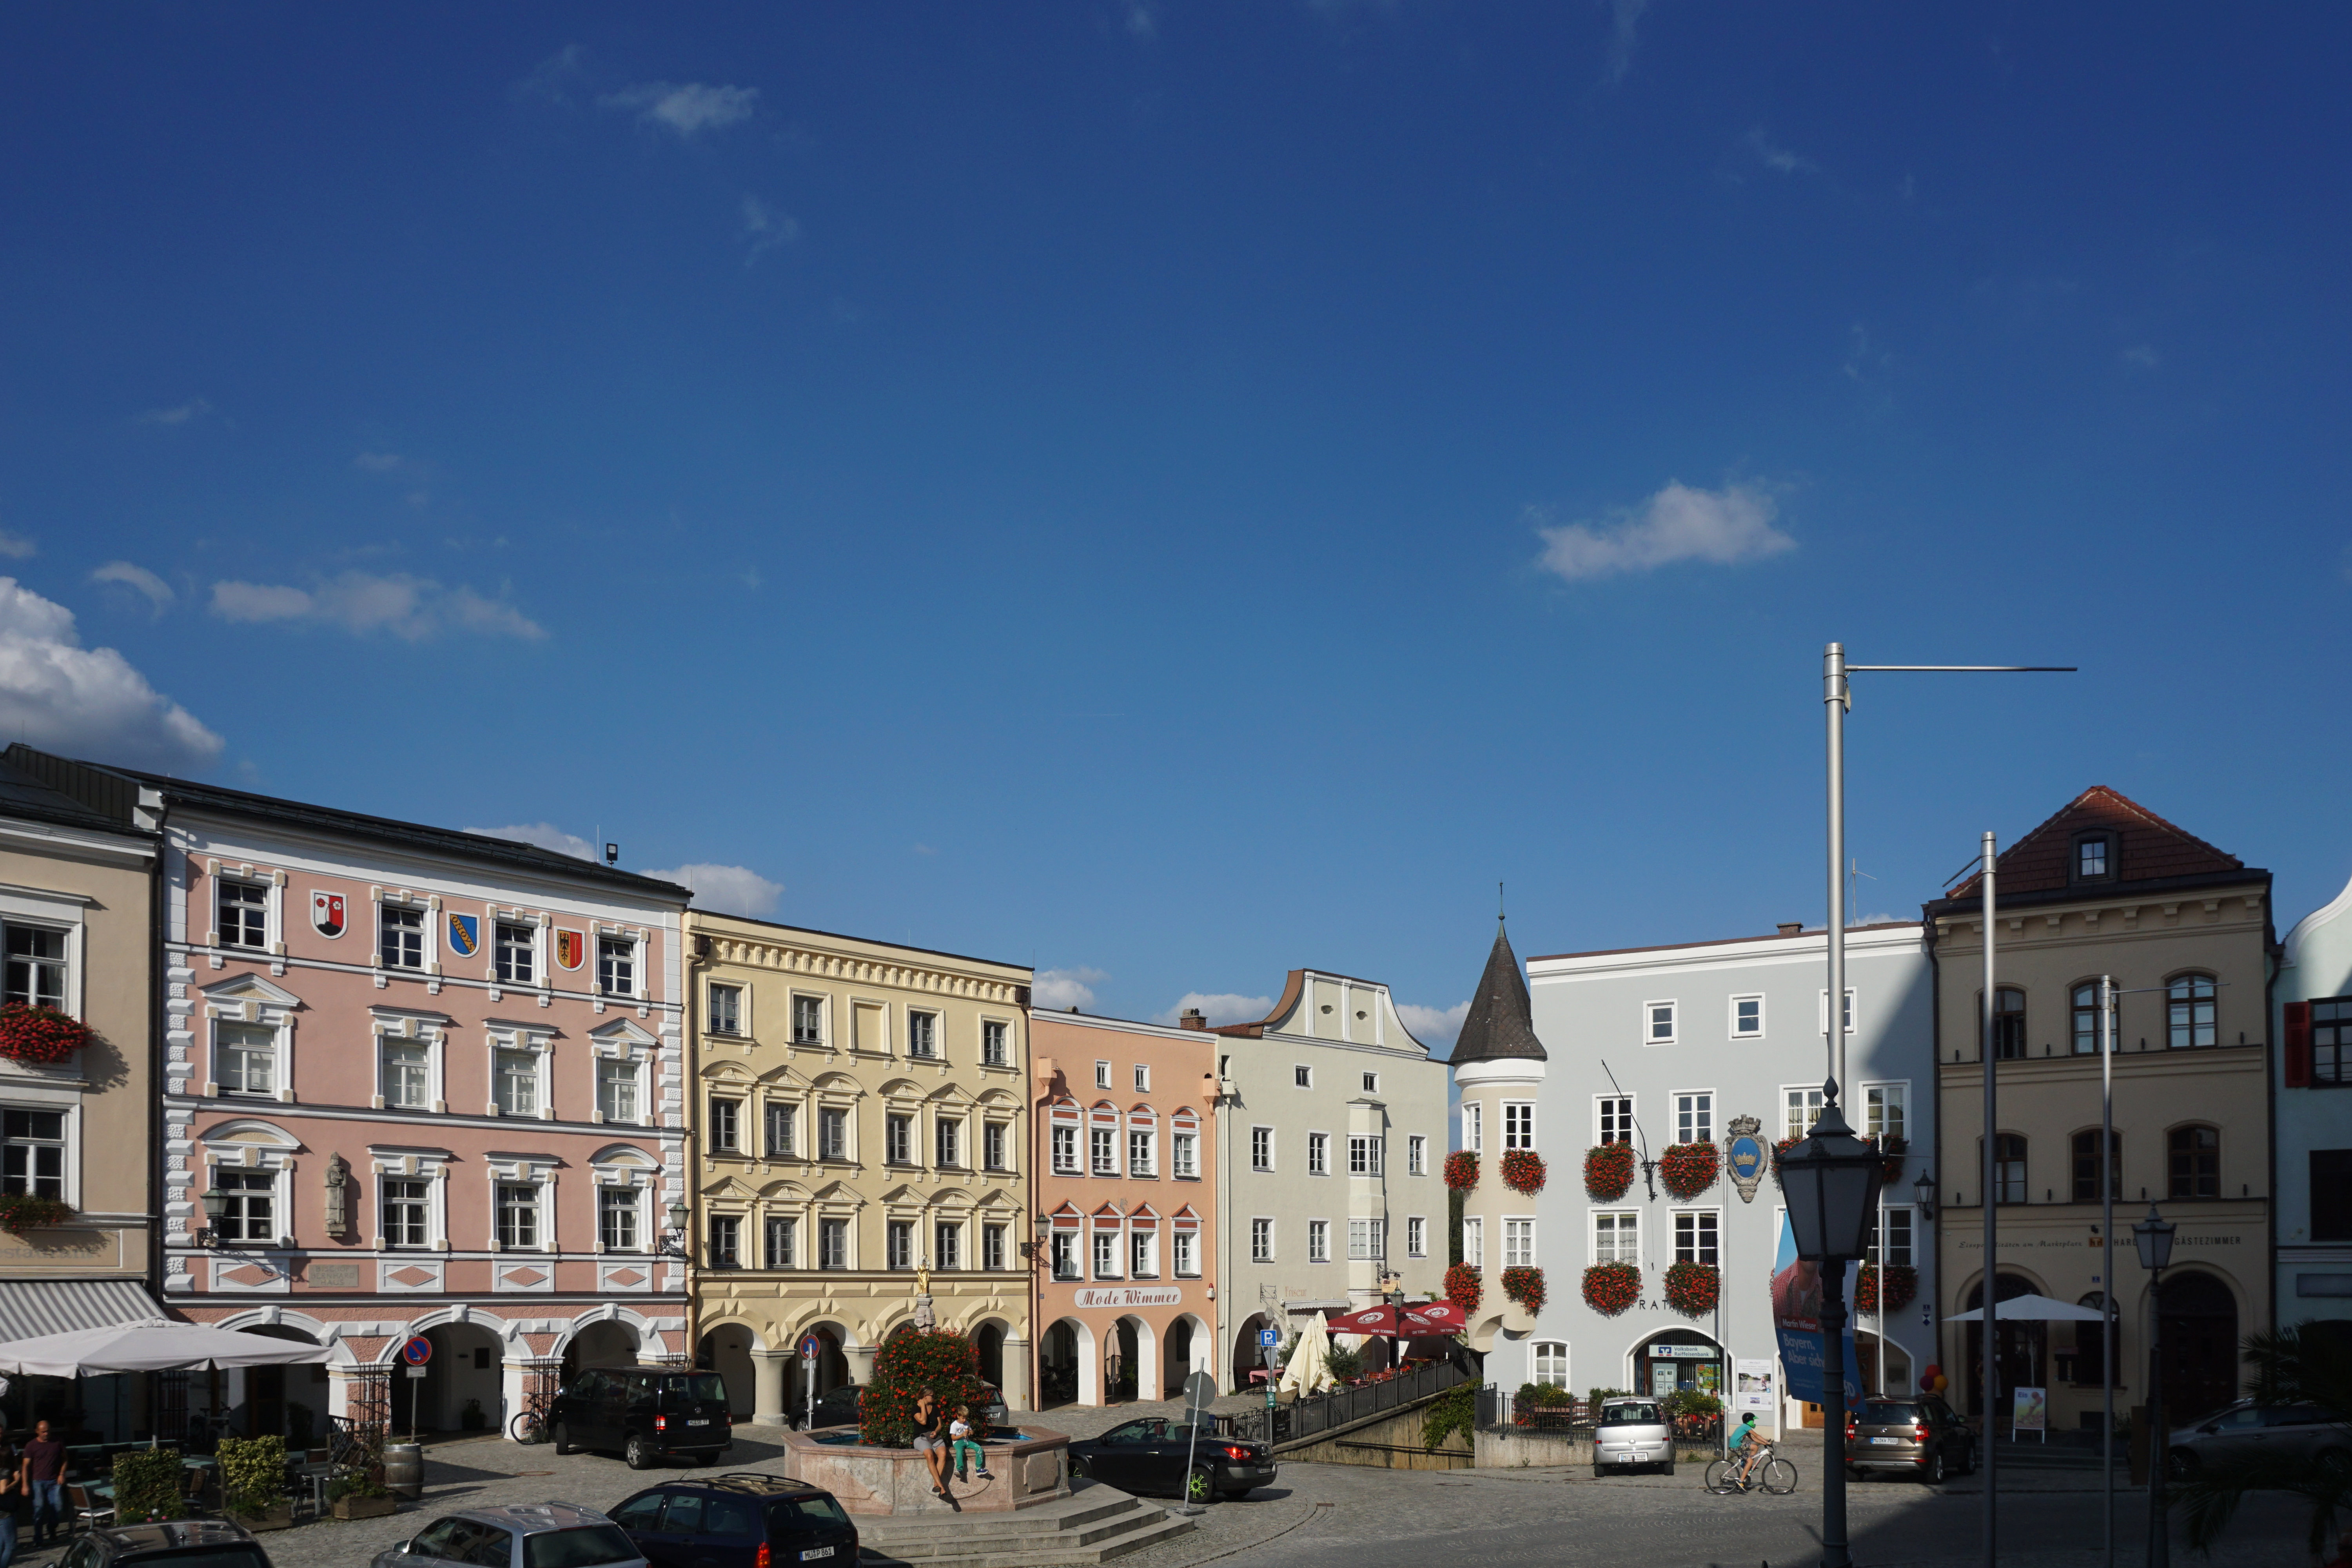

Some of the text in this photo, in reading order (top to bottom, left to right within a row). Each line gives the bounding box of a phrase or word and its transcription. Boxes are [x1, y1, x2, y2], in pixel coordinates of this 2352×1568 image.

[2174, 1236, 2241, 1245] GÄSTEZIMMER
[1080, 1290, 1178, 1305] Mode Wimmer
[1285, 1286, 1307, 1297] Friseur
[1782, 1318, 1816, 1330] Martin Wieser
[1265, 1332, 1273, 1344] P
[1783, 1333, 1815, 1351] Bayern.
[1788, 1350, 1807, 1365] Aber
[1844, 1380, 1855, 1397] fD
[805, 1551, 813, 1559] MÜ
[822, 1548, 832, 1556] 861
